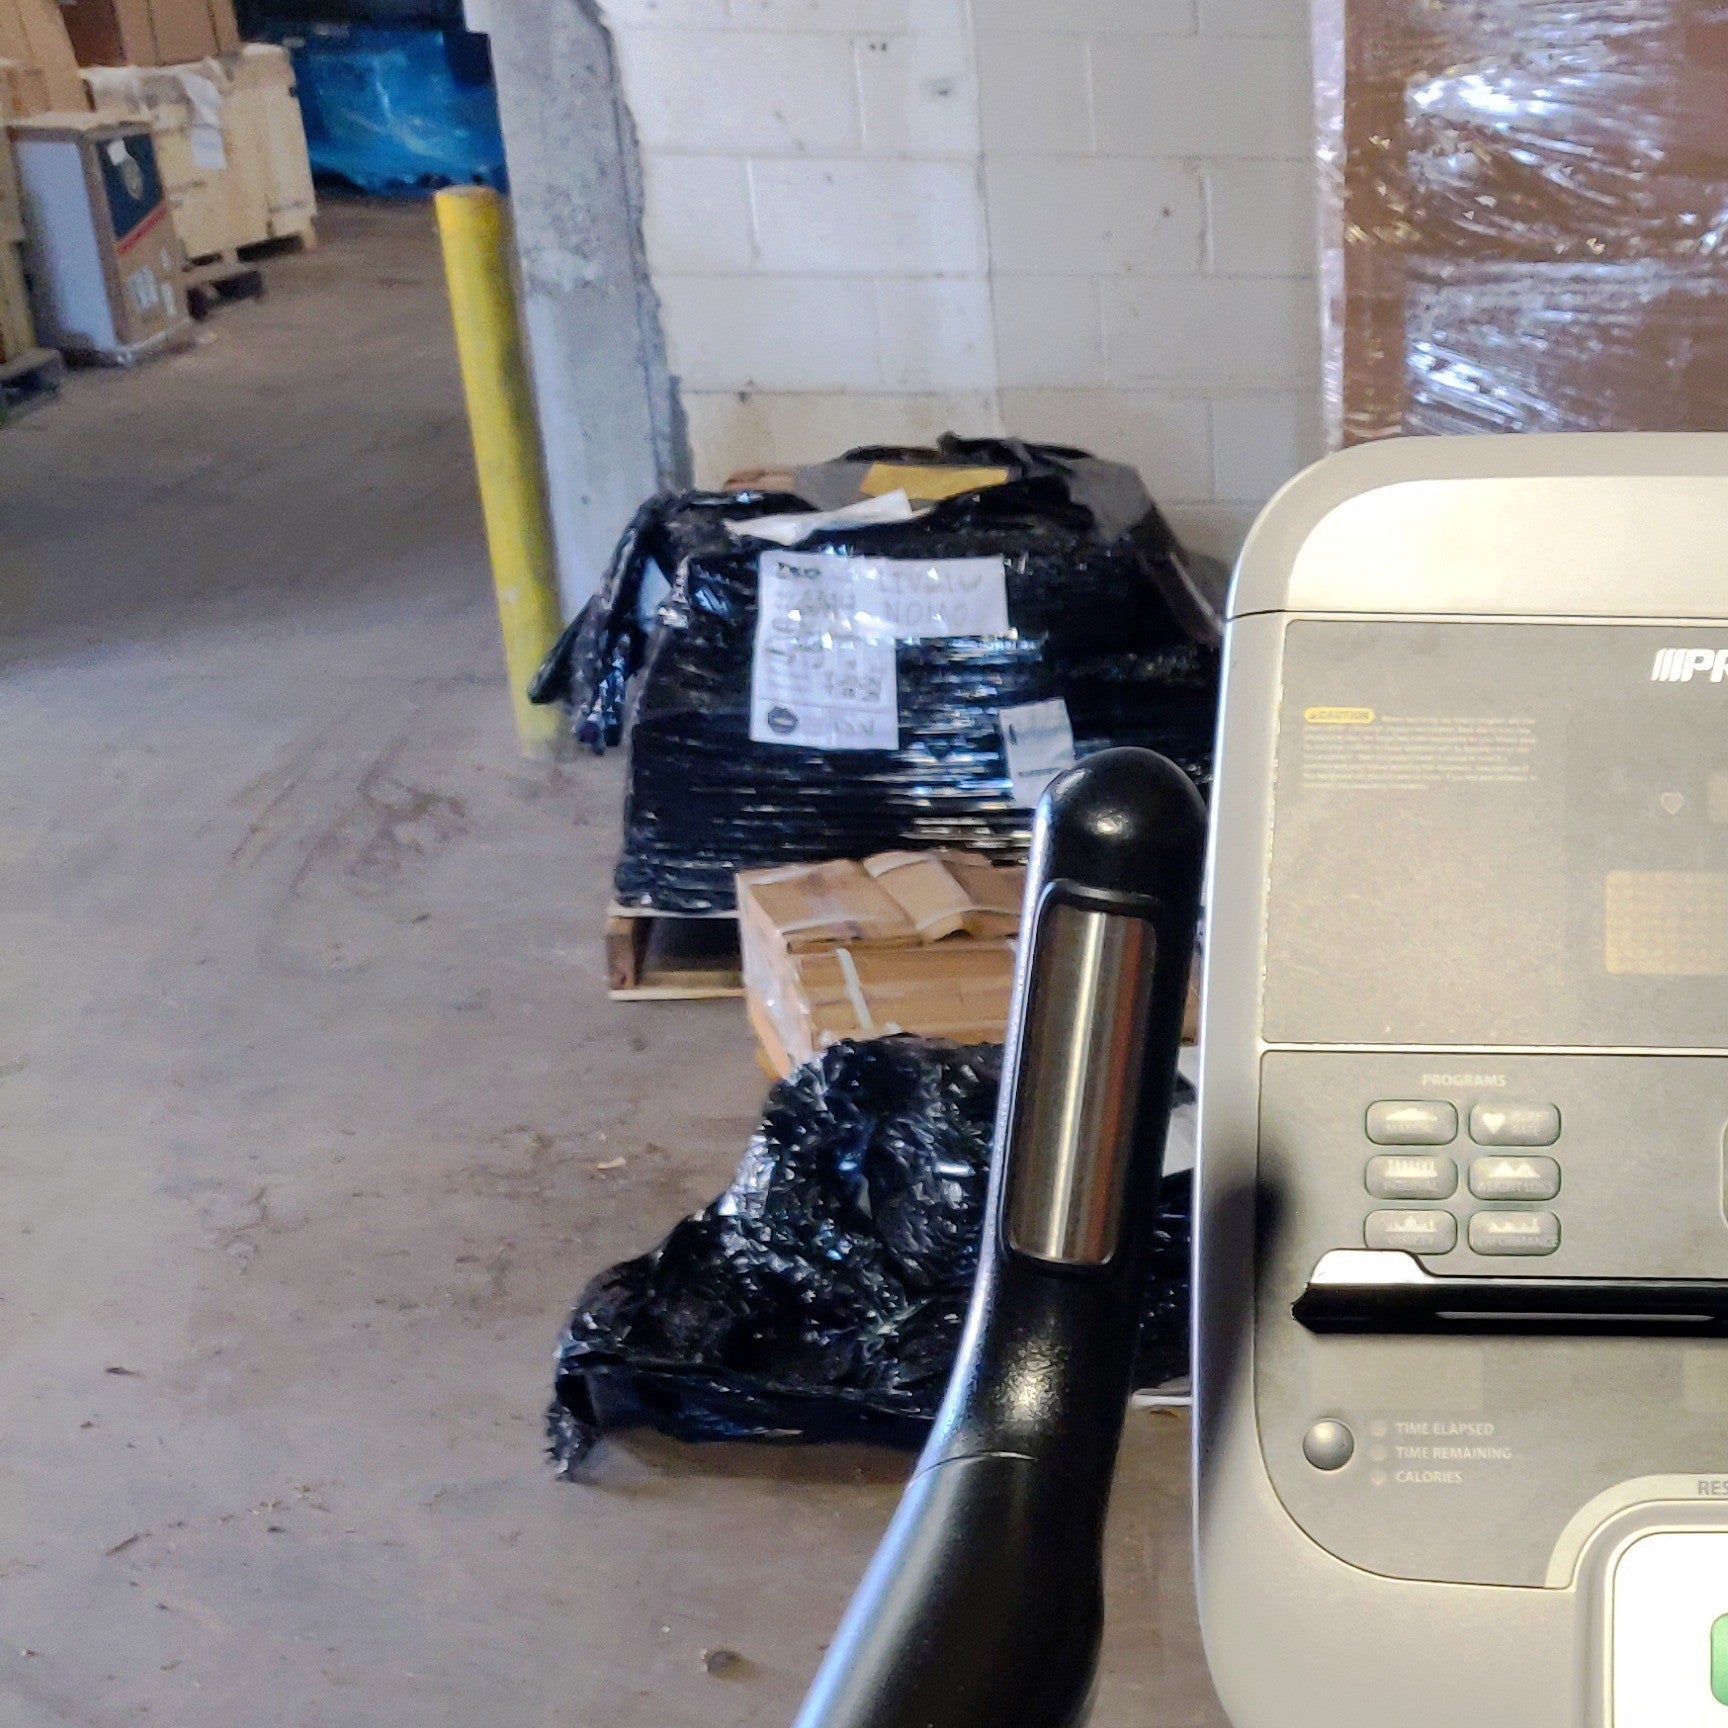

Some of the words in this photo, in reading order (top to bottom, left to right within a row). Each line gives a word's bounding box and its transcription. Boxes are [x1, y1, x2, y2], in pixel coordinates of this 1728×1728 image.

[1422, 1074, 1507, 1086] PROGRAMS
[1396, 1422, 1428, 1435] TIME
[1433, 1423, 1494, 1436] ELAPSED
[1396, 1447, 1429, 1459] TIME
[1433, 1447, 1512, 1460] REMAINING
[1396, 1471, 1463, 1483] CALORIES
